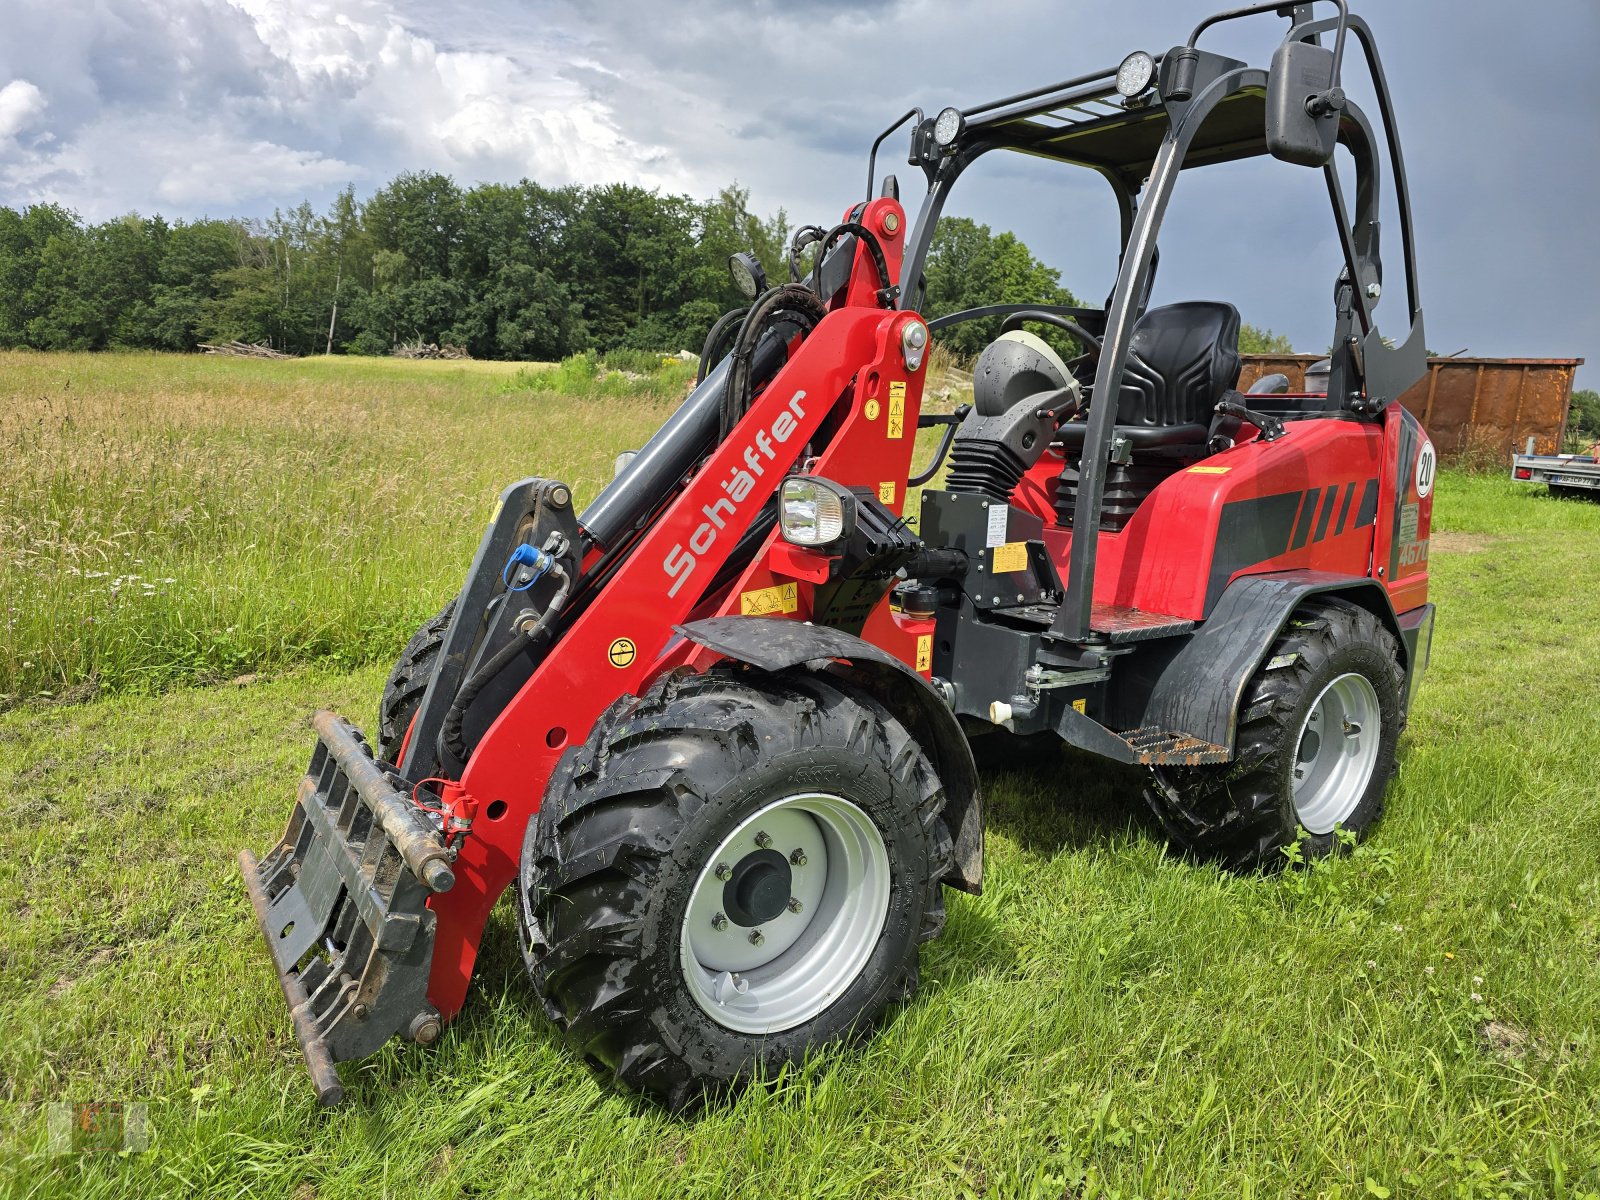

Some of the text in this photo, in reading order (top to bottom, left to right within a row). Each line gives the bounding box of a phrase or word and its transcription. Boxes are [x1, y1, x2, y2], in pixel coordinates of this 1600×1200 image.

[1418, 451, 1433, 487] 20
[663, 389, 807, 598] Schäffer
[1399, 539, 1430, 567] 4670
